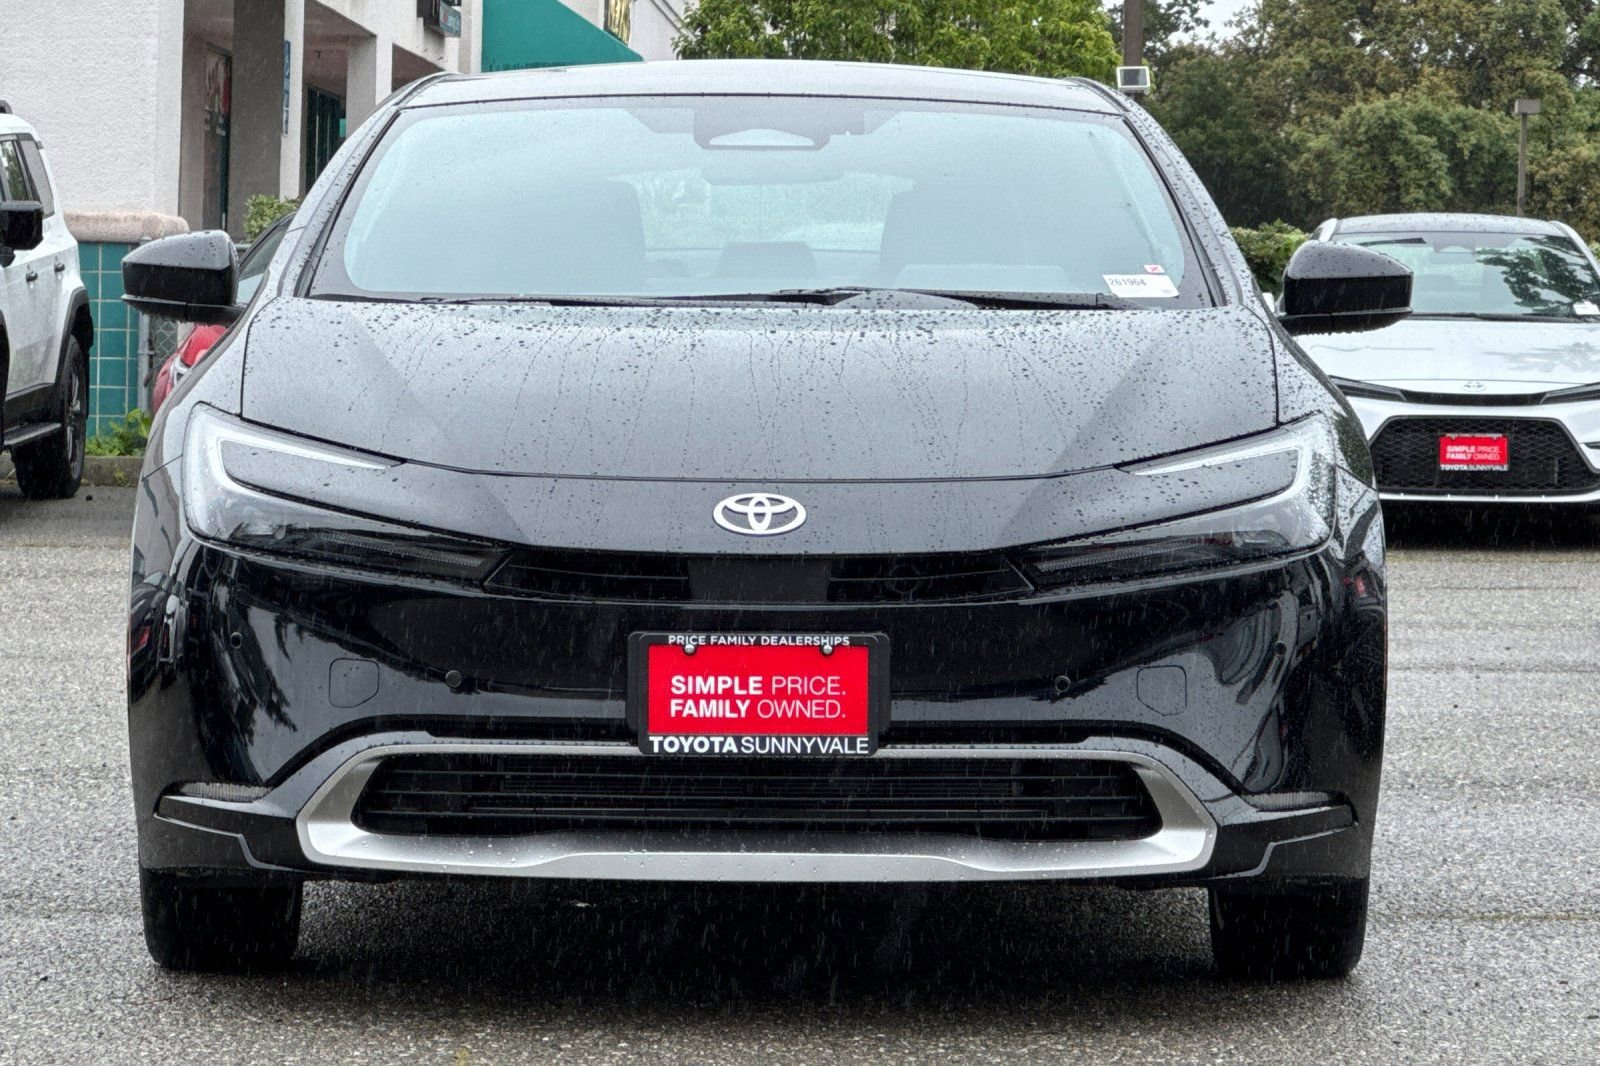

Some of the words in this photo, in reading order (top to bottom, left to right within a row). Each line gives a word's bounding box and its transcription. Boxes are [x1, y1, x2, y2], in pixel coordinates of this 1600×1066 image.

[1446, 445, 1475, 453] SIMPLE
[668, 635, 706, 645] PRICE
[710, 636, 756, 646] FAMILY
[760, 636, 850, 646] DEALERSHIPS
[671, 676, 763, 695] SIMPLE
[771, 676, 847, 695] PRICE.
[670, 699, 750, 718] FAMILY
[757, 700, 846, 718] OWNED.
[649, 736, 739, 753] TOYOTA
[740, 737, 869, 754] SUNNYVALE
